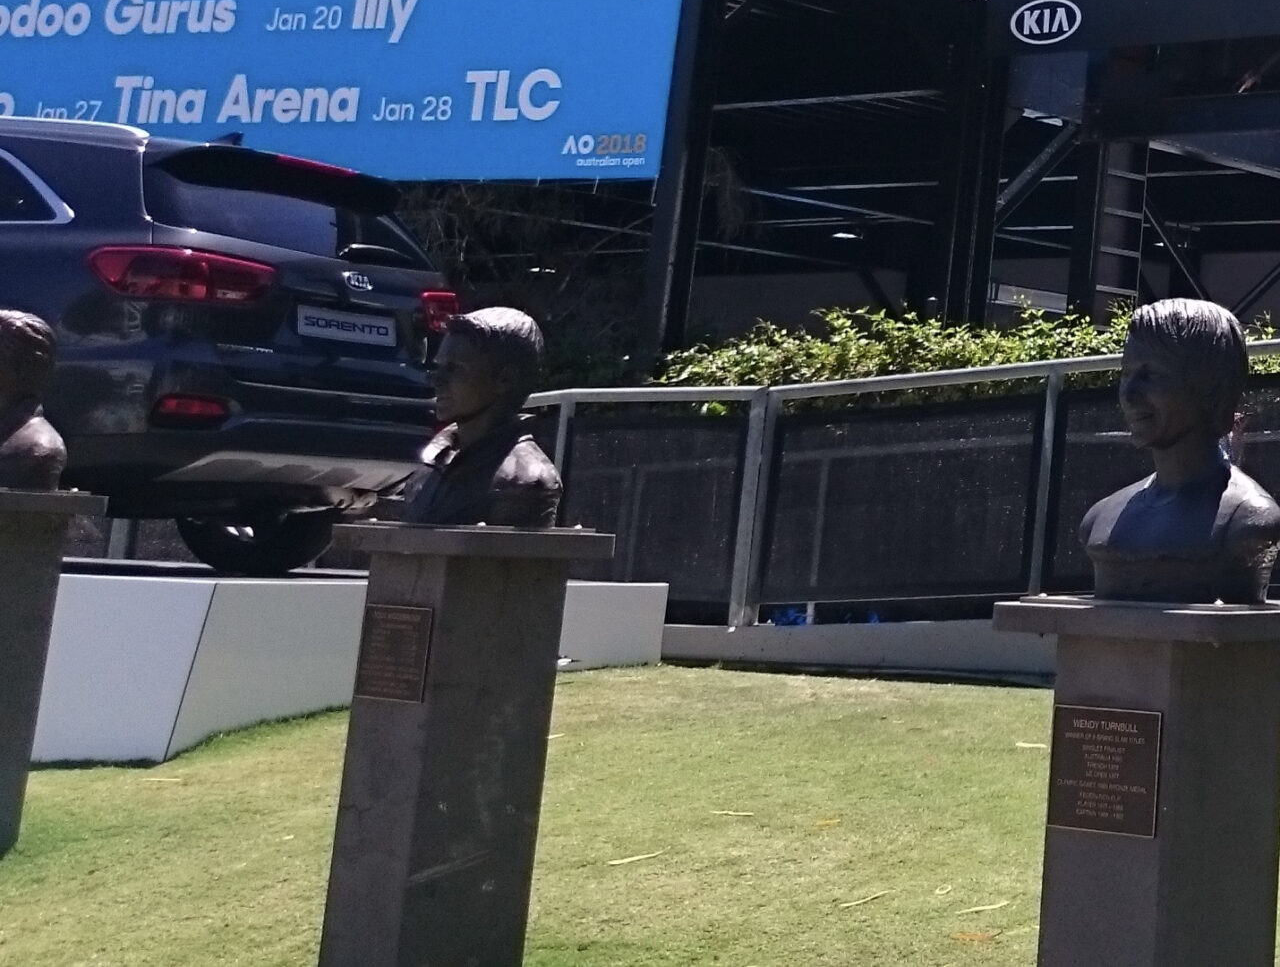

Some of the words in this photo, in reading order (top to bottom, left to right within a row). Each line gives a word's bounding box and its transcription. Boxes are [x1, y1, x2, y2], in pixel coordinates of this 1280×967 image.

[265, 7, 306, 32] Jan
[311, 5, 342, 31] 20
[1023, 7, 1070, 35] KIA
[115, 75, 207, 124] Tina
[216, 74, 360, 125] Arena
[372, 96, 417, 123] Jan
[421, 95, 452, 121] 28
[465, 68, 563, 122] TLC
[561, 134, 595, 155] AO
[596, 133, 647, 154] 2018
[576, 157, 621, 166] australian
[622, 157, 645, 168] open
[304, 315, 390, 337] SORENTO
